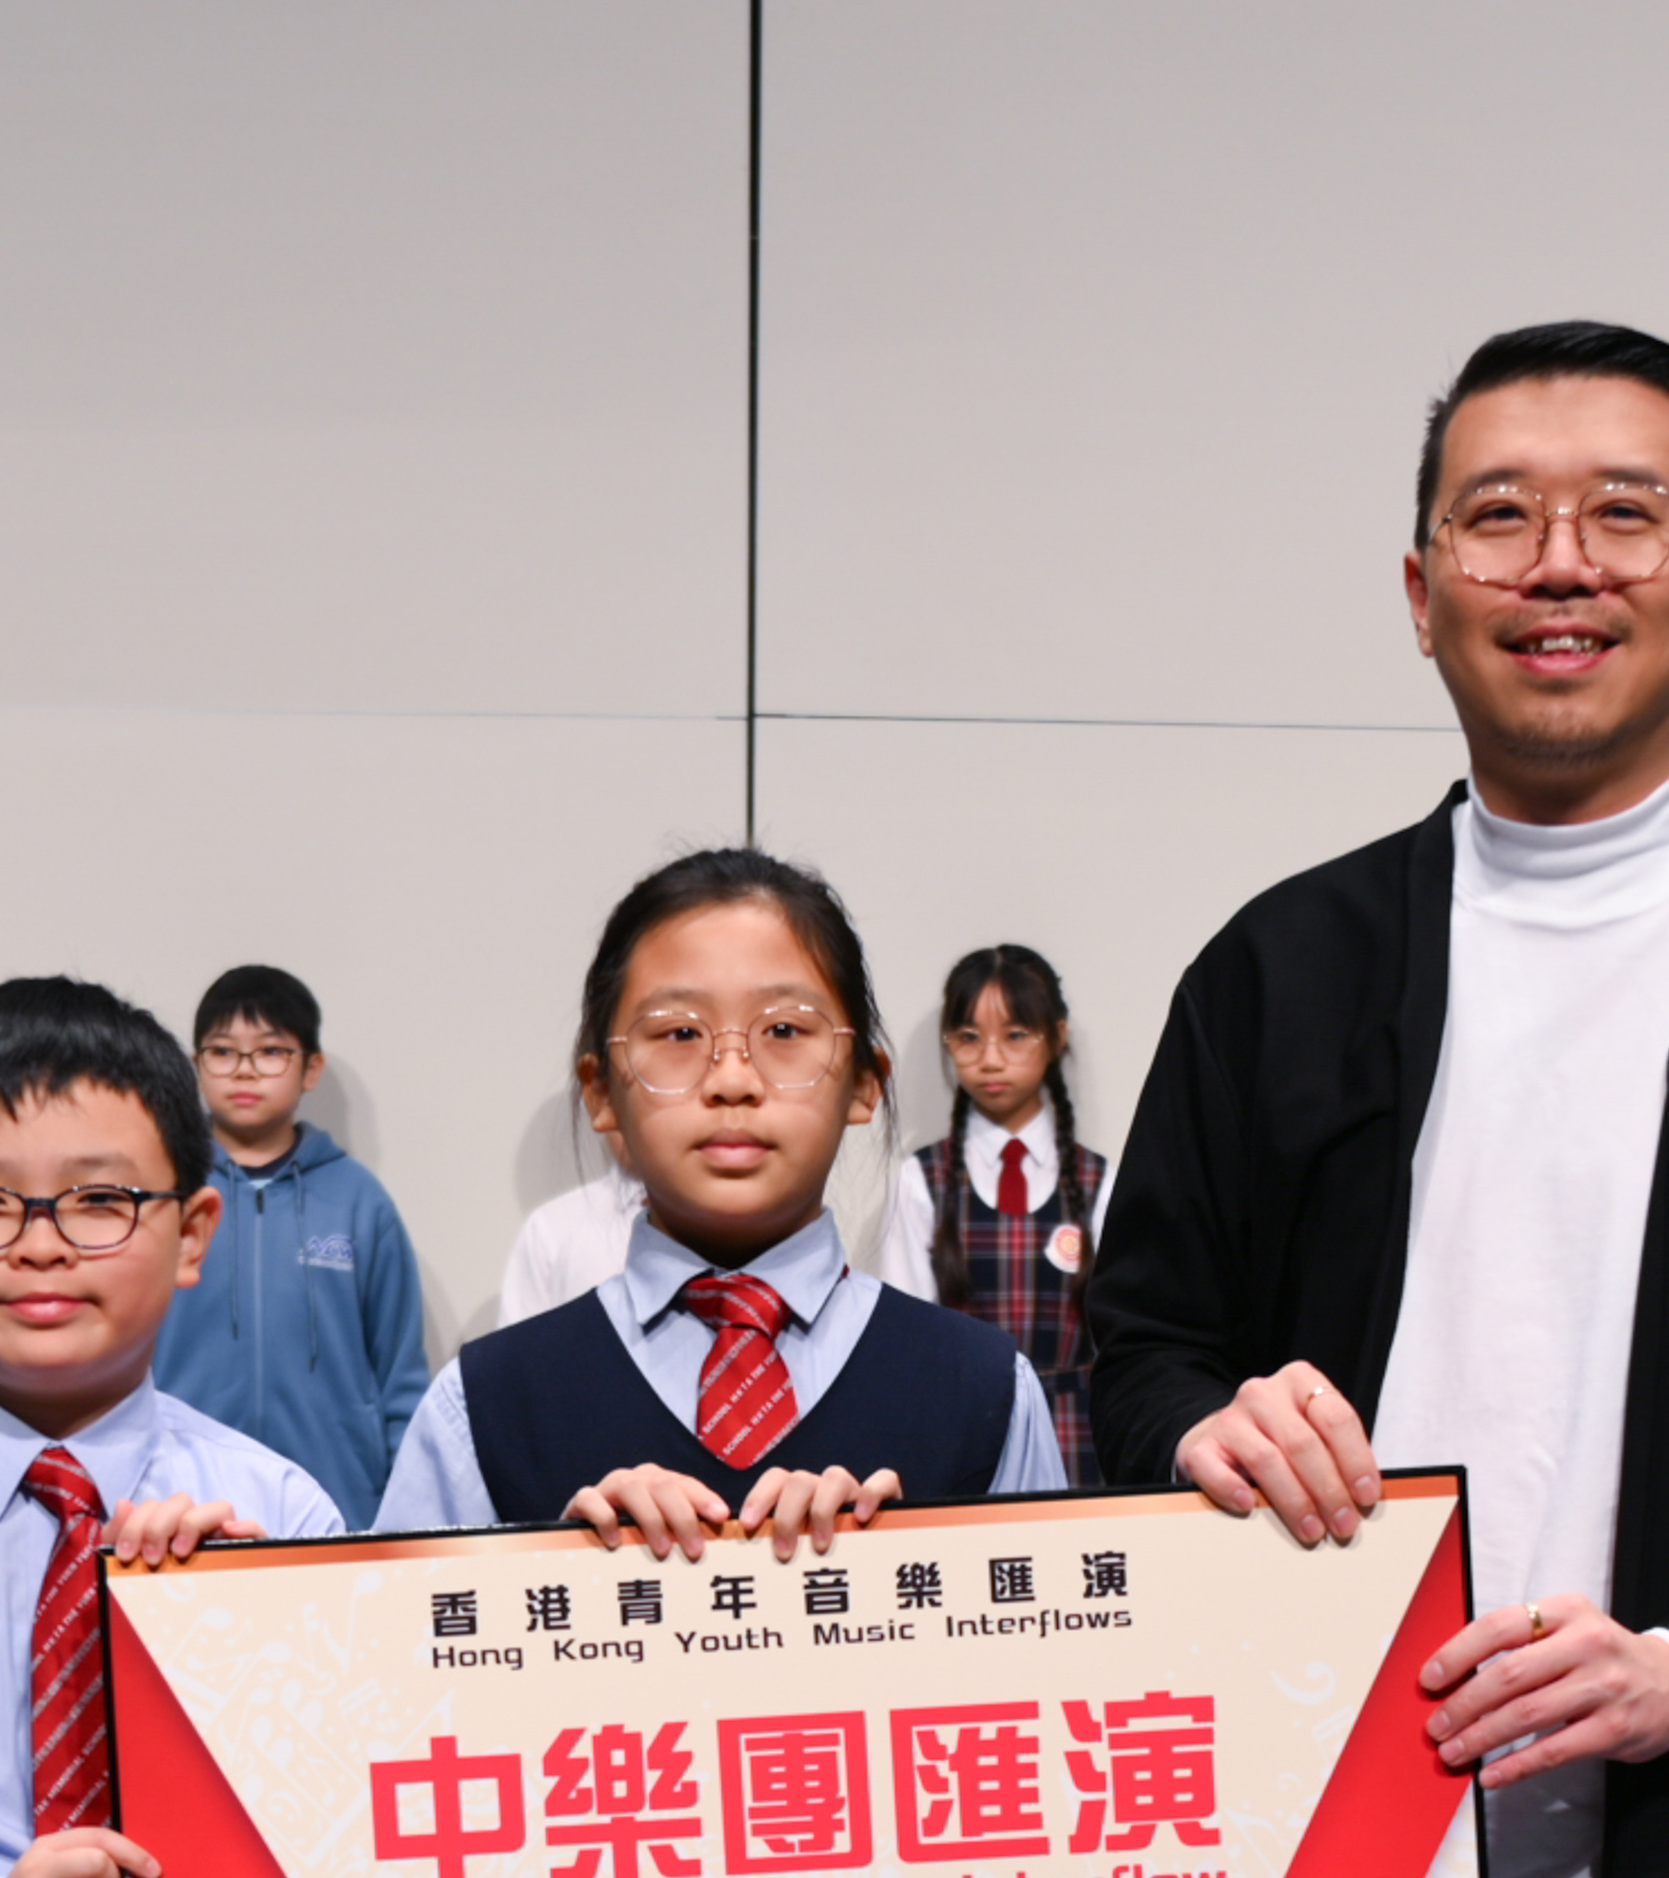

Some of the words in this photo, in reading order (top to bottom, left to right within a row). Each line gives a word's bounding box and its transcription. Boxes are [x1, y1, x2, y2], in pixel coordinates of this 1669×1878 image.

[431, 1551, 1128, 1638] 香港青年音樂匯演
[432, 1646, 524, 1670] Hong
[553, 1638, 644, 1663] Kong
[674, 1627, 784, 1653] Youth
[813, 1619, 916, 1646] Music
[946, 1609, 1133, 1638] Interflows
